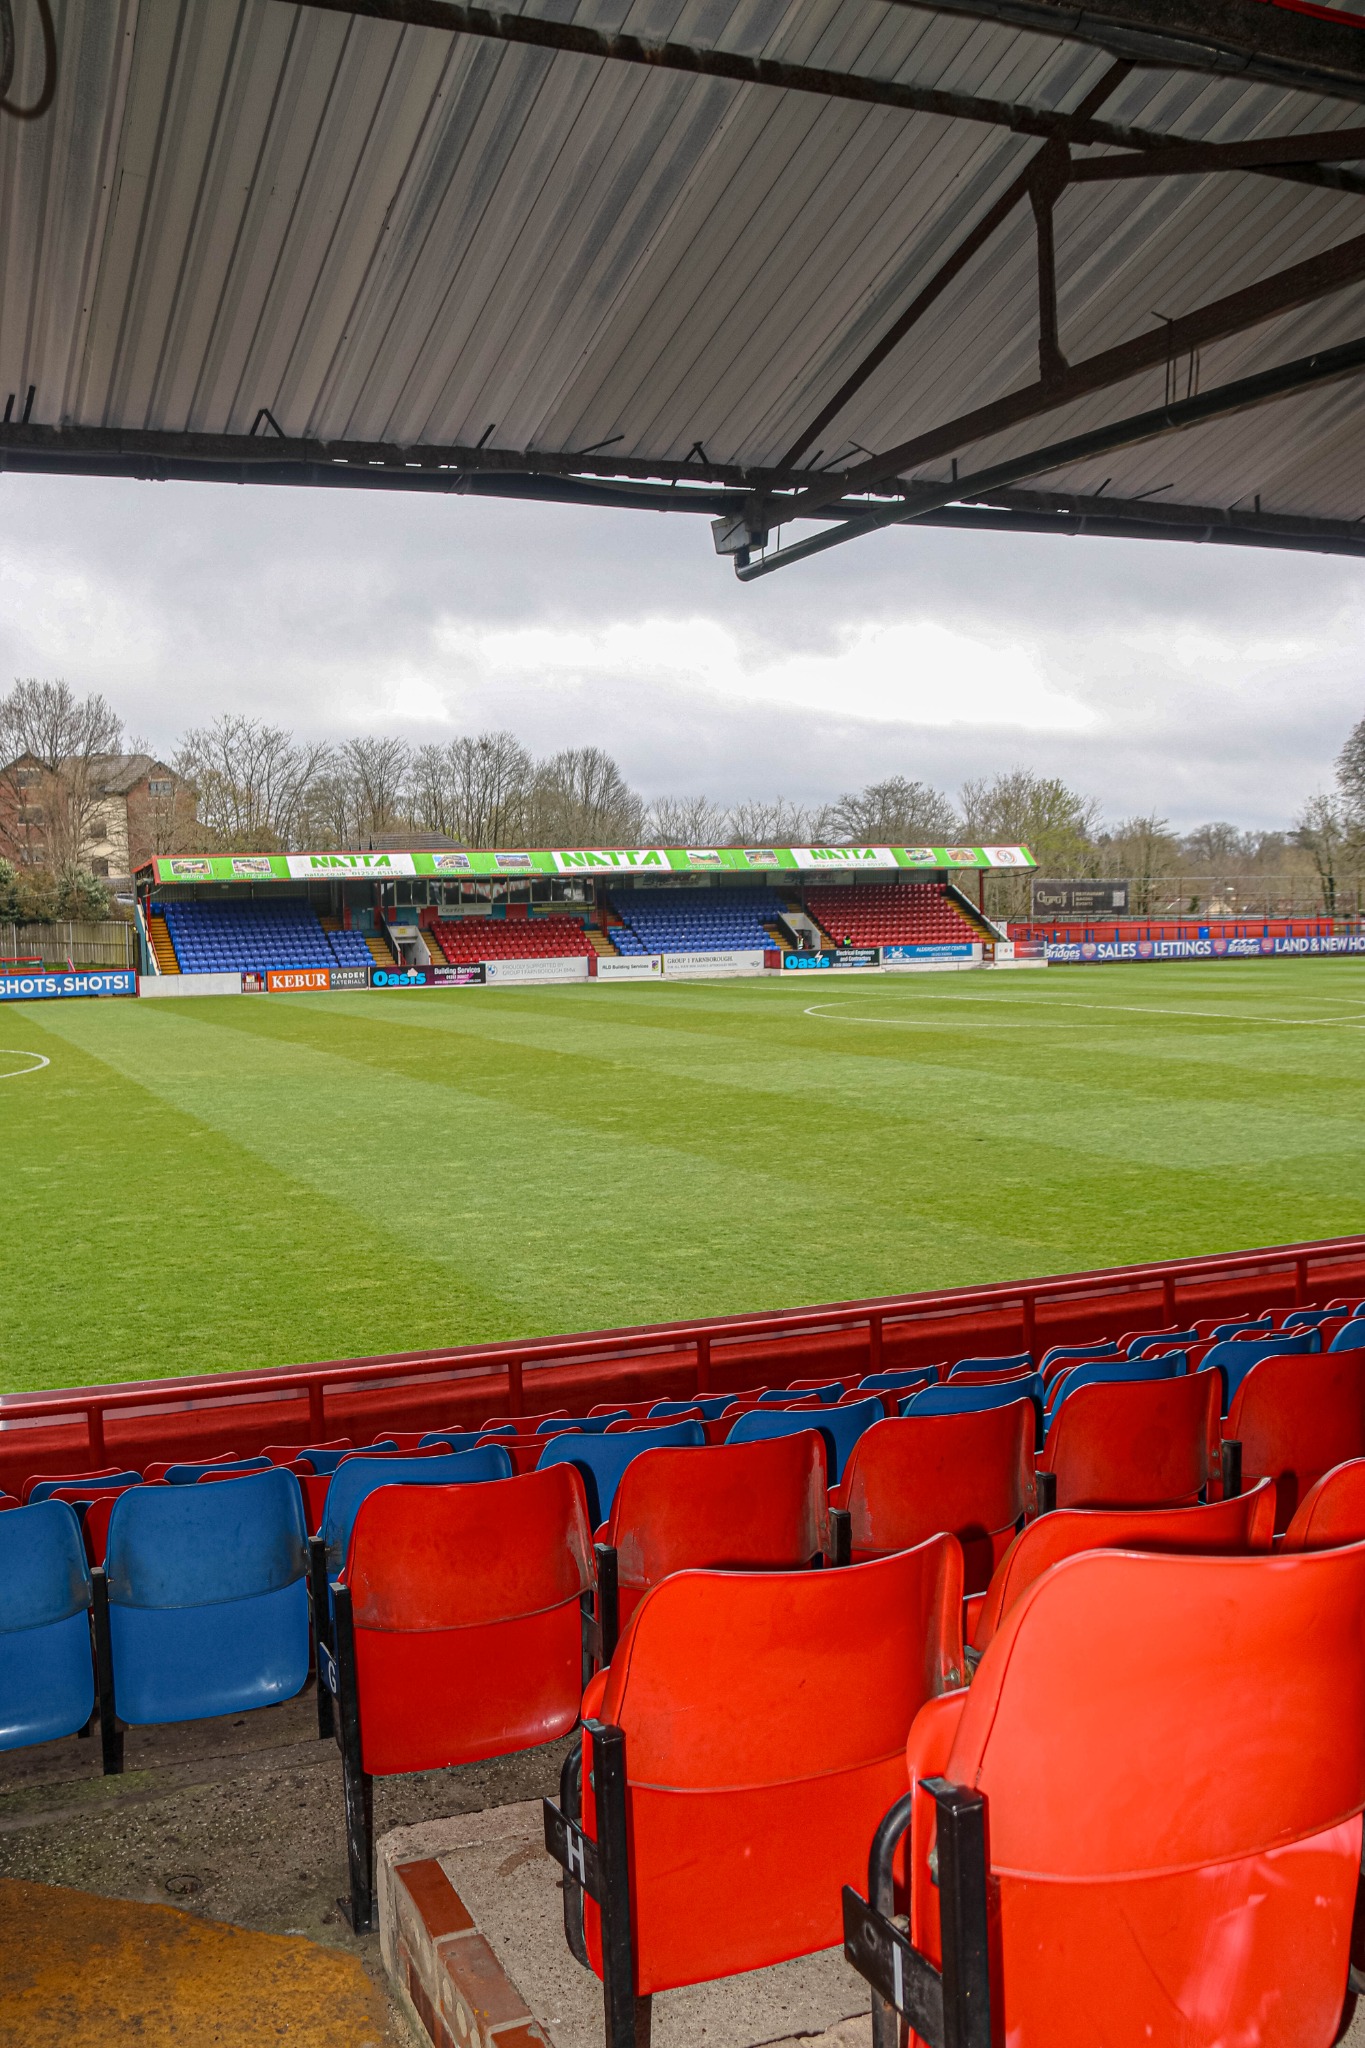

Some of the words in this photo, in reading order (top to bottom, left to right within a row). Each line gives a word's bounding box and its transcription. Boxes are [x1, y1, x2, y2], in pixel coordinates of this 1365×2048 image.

[309, 855, 391, 868] NATTA
[560, 850, 662, 867] NATTA
[809, 848, 877, 860] NATTA
[1097, 943, 1136, 958] SALES
[1154, 940, 1211, 956] LETTINGS
[1275, 938, 1310, 952] LAND
[1310, 938, 1320, 951] &
[1321, 938, 1348, 952] NEW
[785, 954, 830, 970] Oasis
[63, 975, 129, 992] SHOTS!
[272, 973, 327, 988] KEBUR
[372, 969, 426, 986] Oasis
[328, 1660, 337, 1694] G
[566, 1824, 586, 1884] H
